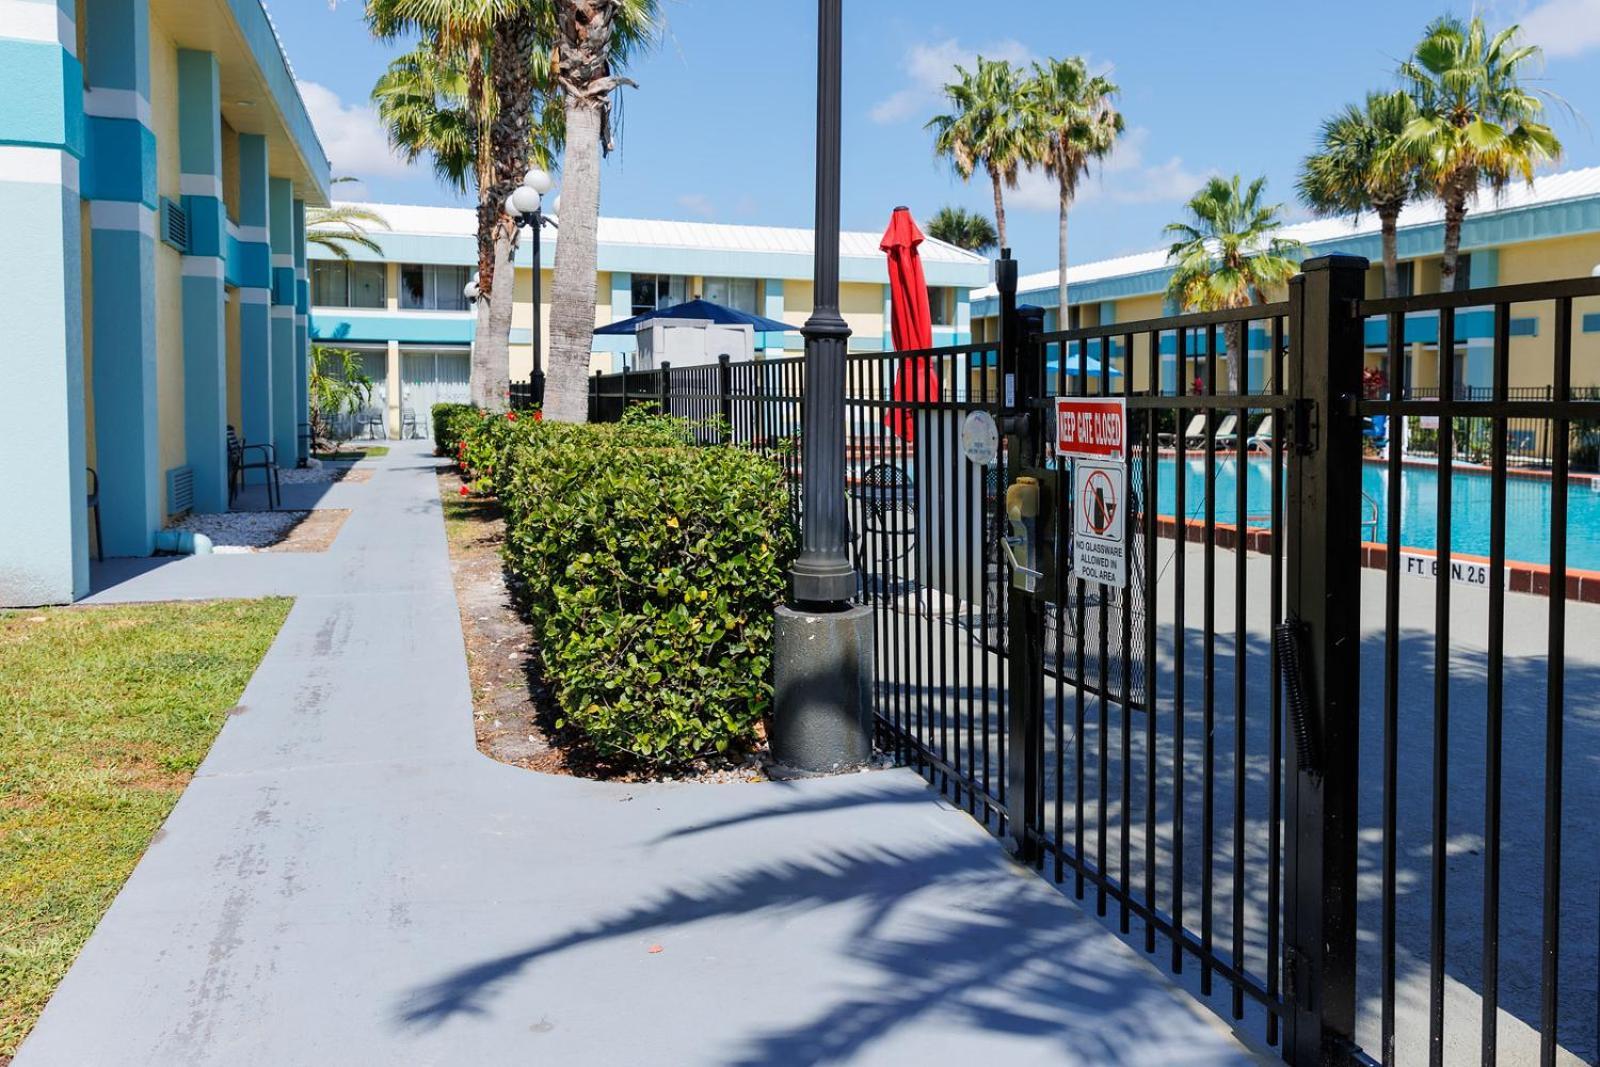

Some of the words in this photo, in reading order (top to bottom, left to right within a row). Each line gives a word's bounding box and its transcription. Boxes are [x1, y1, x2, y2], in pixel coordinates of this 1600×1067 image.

[1060, 412, 1075, 441] KEEP
[1077, 412, 1094, 444] GATE
[1095, 413, 1121, 446] CLOSED
[1076, 541, 1084, 550] NO
[1086, 542, 1122, 557] GLASSWARE
[1081, 554, 1109, 568] ALLOWED
[1110, 560, 1117, 569] IN
[1082, 566, 1098, 578] POOL
[1099, 570, 1115, 581] AREA
[1408, 557, 1424, 574] FT.
[1468, 566, 1485, 584] 2.6
